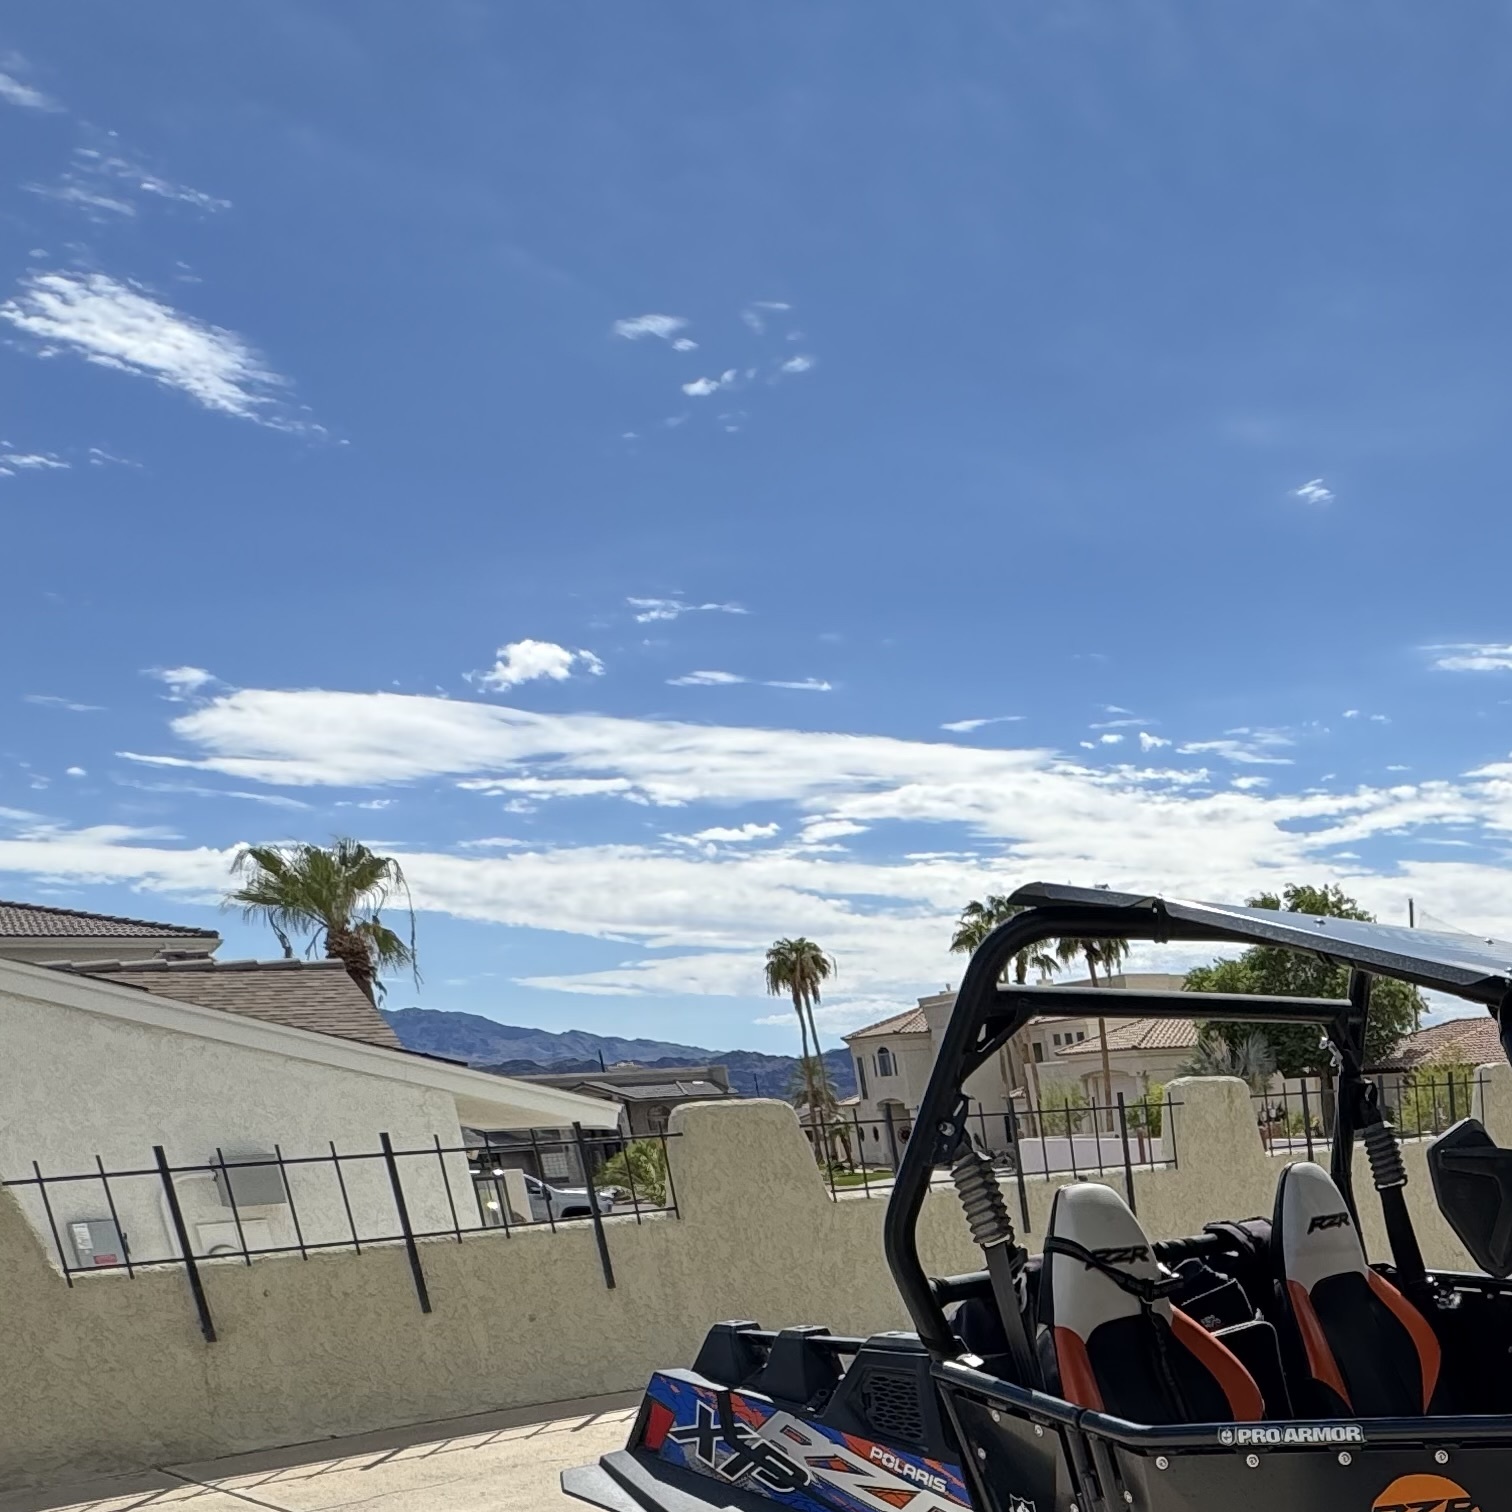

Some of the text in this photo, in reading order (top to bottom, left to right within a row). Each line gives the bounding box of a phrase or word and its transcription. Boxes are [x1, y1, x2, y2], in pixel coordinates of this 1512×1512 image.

[1307, 1211, 1350, 1235] RZR
[1237, 1426, 1362, 1444] PRO ARMOR
[869, 1445, 948, 1494] POLARIS
